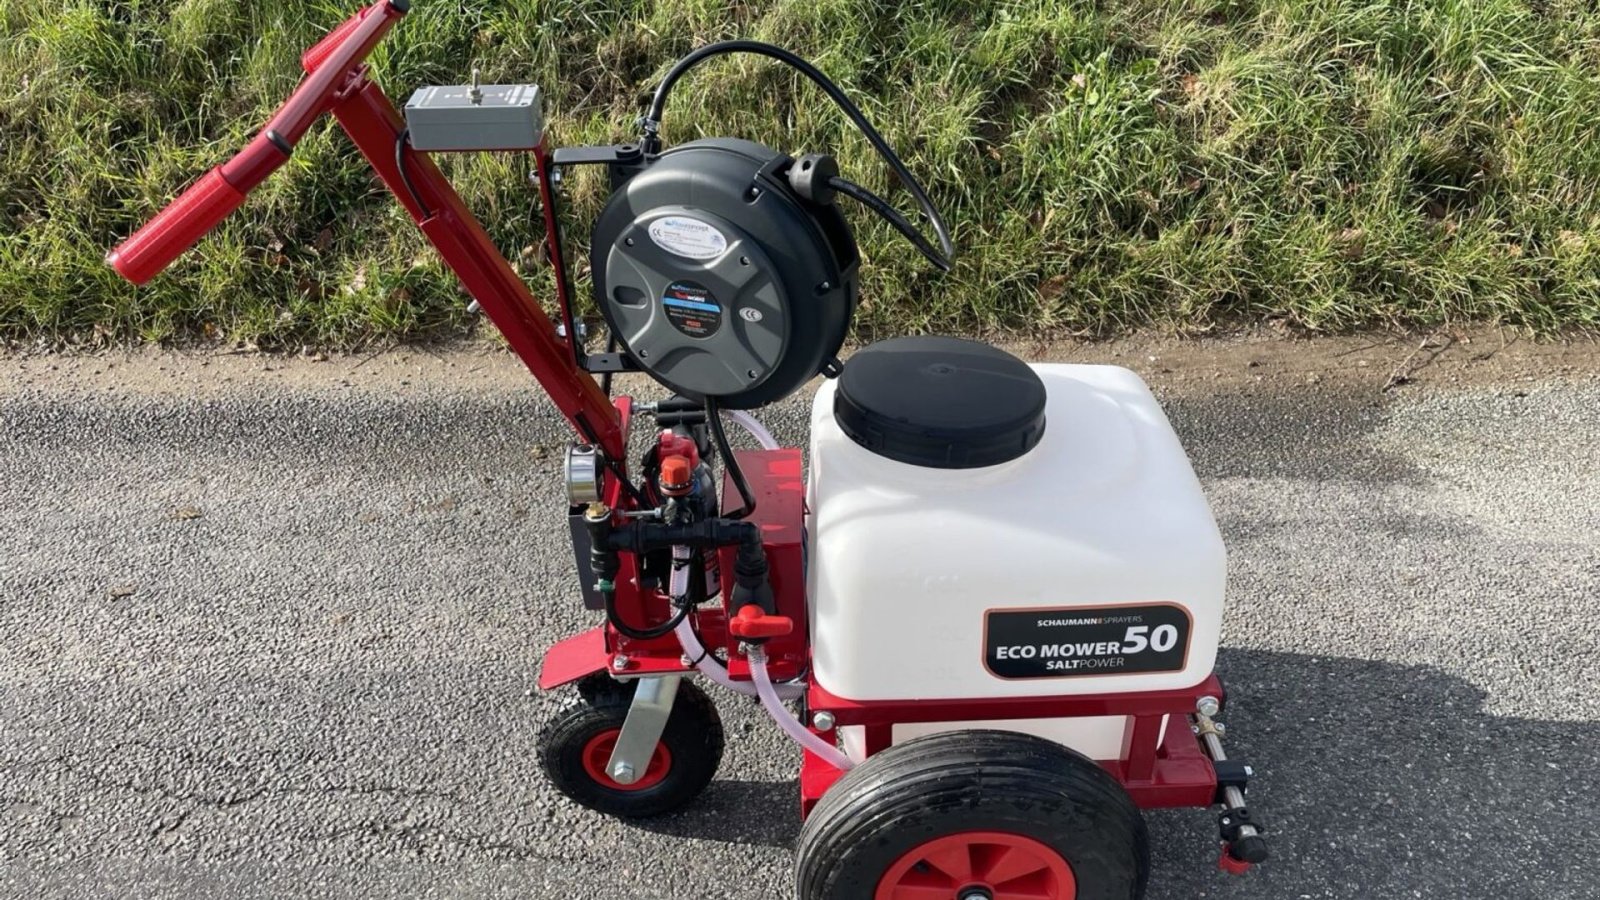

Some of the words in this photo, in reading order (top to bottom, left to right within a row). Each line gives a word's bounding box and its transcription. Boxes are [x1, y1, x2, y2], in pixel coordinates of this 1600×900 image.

[1037, 618, 1098, 627] SCHAUMANN
[1103, 615, 1143, 624] SPRAYERS
[996, 645, 1036, 660] ECO
[1039, 641, 1120, 658] MOWER
[1121, 624, 1178, 654] 50
